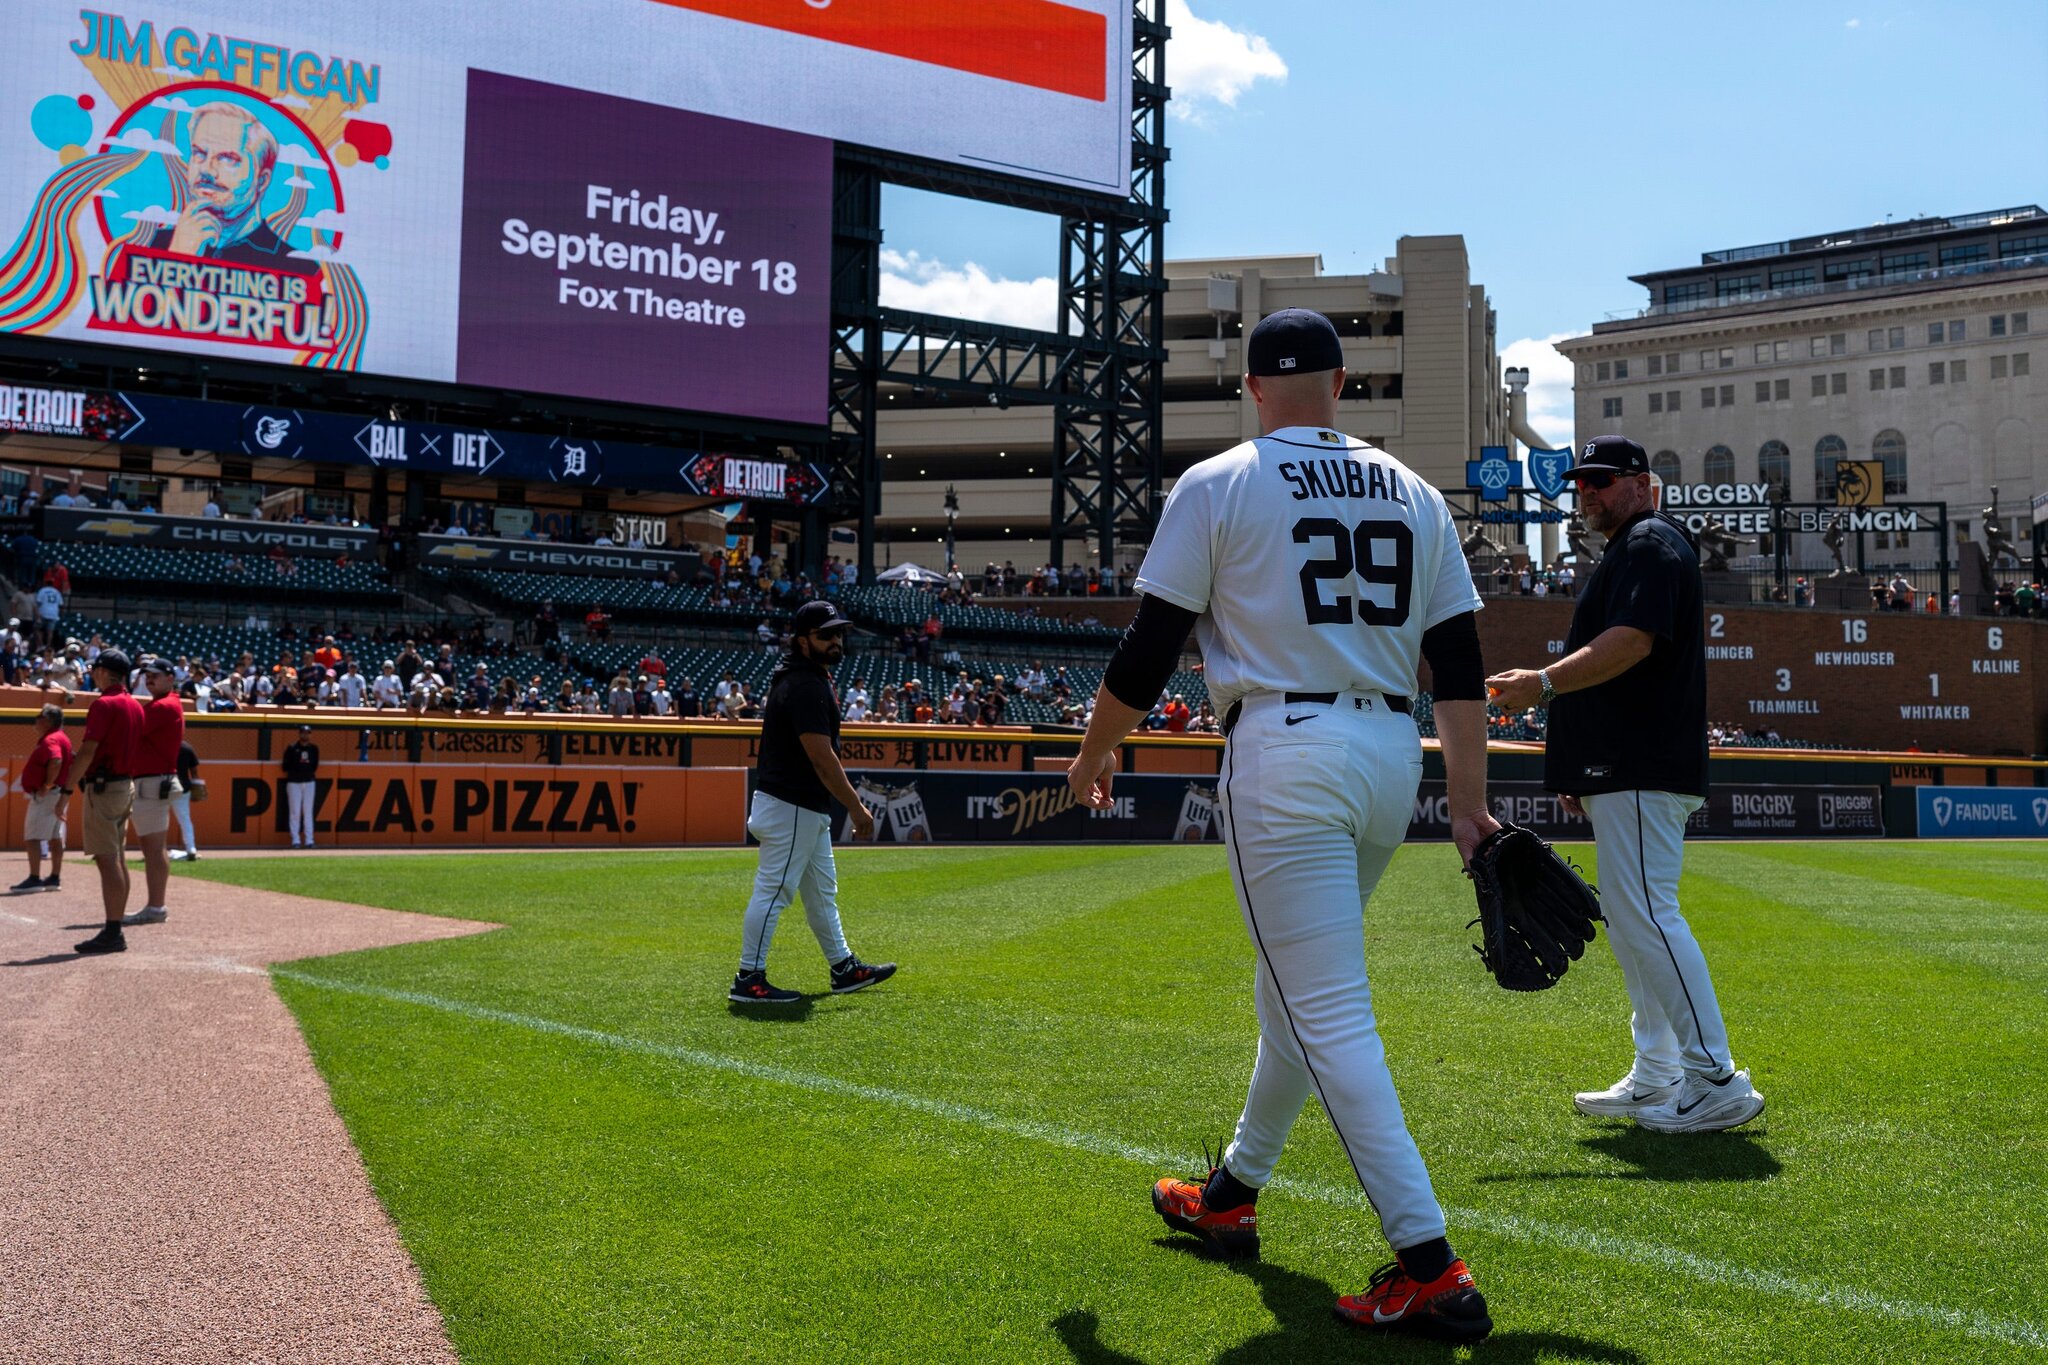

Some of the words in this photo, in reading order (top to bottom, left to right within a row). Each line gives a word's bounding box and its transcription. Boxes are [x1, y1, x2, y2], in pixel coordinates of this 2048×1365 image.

[69, 8, 154, 67] JIM
[164, 27, 382, 104] GAFFIGAN
[585, 184, 727, 246] Friday,
[500, 218, 741, 288] September
[751, 259, 799, 297] 18
[131, 255, 280, 300] EVERYTHING
[283, 275, 308, 305] IS
[90, 276, 336, 349] WONDERFUL!
[558, 277, 619, 313] Fox
[623, 285, 747, 330] Theatre
[0, 384, 87, 428] DETROIT
[12, 422, 52, 434] MATTER
[370, 424, 408, 461] BAL
[452, 432, 489, 468] DET
[723, 458, 788, 493] DETROIT
[1278, 459, 1408, 507] SKUBAL
[735, 489, 764, 498] MATTER
[1666, 483, 1770, 505] BIGGBY
[1481, 510, 1563, 524] MICHIGAN
[172, 525, 368, 551] CHEVROLET
[509, 549, 675, 572] CHEVROLET
[1291, 516, 1415, 628] 29
[1709, 614, 1725, 638] 2
[1841, 618, 1868, 644] 16
[1987, 627, 2004, 650] 6
[1815, 651, 1895, 666] NEWHOUSER
[1972, 659, 2021, 674] KALINE
[1775, 668, 1792, 692] 3
[1928, 673, 1940, 698] 1
[1748, 700, 1821, 715] TRAMMELL
[1900, 705, 1971, 720] WHITAKER
[429, 731, 525, 753] Caesars
[1892, 765, 1933, 779] LIVERY
[452, 778, 638, 834] PIZZA!
[894, 799, 923, 828] Lite
[1000, 784, 1080, 836] Mill
[1186, 798, 1211, 822] Lite
[1731, 794, 1795, 815] BIGGBY
[1835, 796, 1873, 810] BIGGBY
[1956, 803, 2018, 821] FANDUEL
[1733, 816, 1762, 829] makes
[1763, 816, 1770, 829] it
[1771, 816, 1797, 829] better
[1836, 814, 1876, 829] COFFEE
[1239, 1216, 1256, 1224] 29
